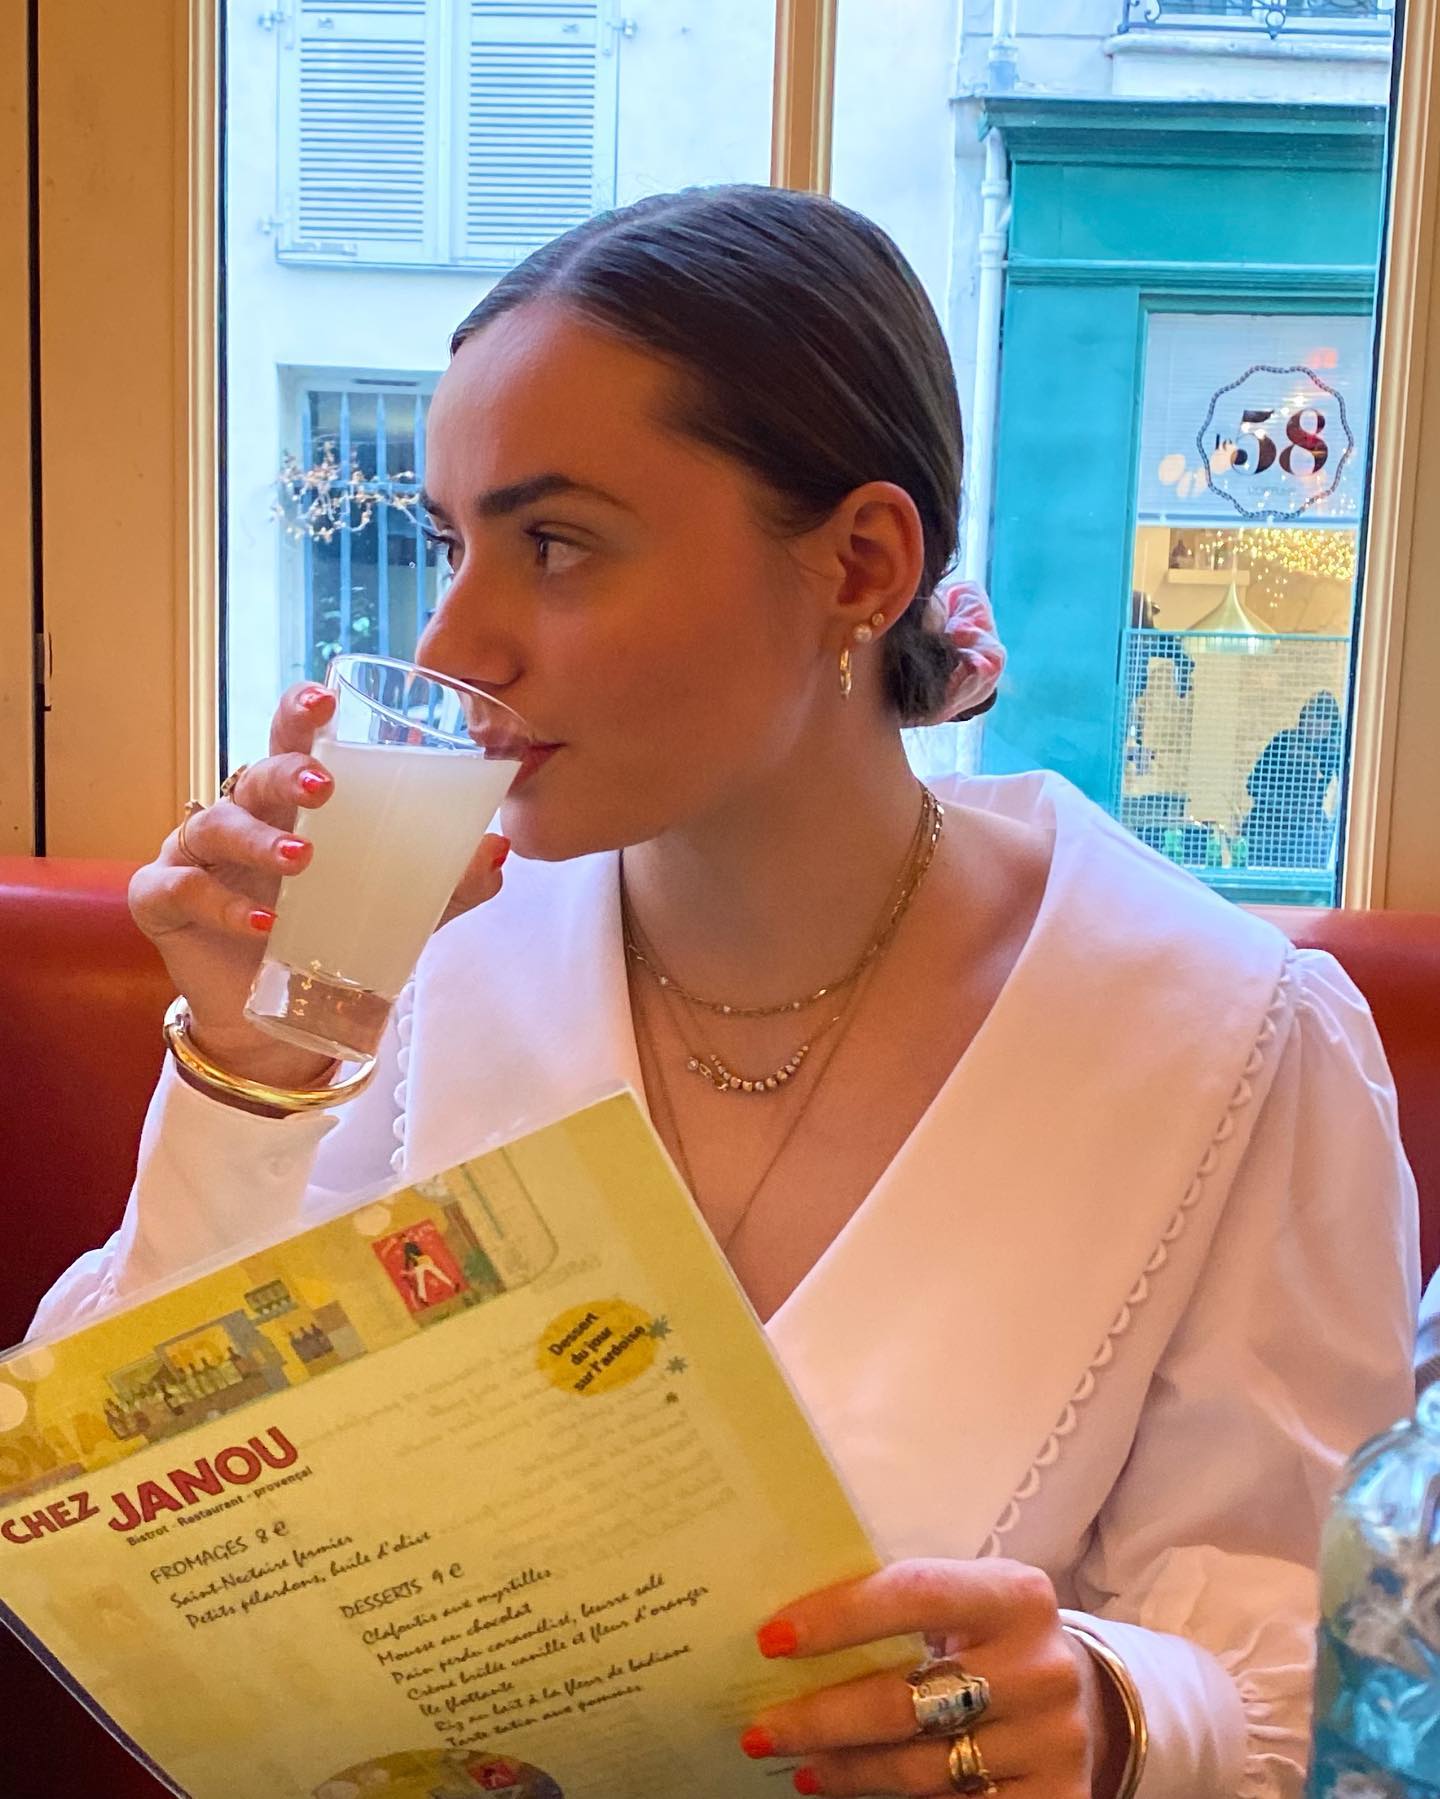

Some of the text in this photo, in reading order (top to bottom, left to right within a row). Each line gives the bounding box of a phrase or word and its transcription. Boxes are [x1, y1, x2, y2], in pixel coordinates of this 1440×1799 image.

[1231, 408, 1328, 476] 58
[548, 1312, 600, 1356] Dessert
[571, 1327, 613, 1365] du jour
[574, 1371, 595, 1391] sur
[0, 1426, 299, 1544] CHEZ JANOU
[127, 1524, 170, 1546] Bistrot
[177, 1495, 244, 1526] Restaurant
[253, 1466, 313, 1499] provençal
[150, 1520, 289, 1584] FROMAGES 8 €
[170, 1536, 353, 1609] Saint-Nectaire fermier
[185, 1605, 236, 1629] Petits
[330, 1552, 371, 1576] huile
[377, 1532, 431, 1559] d'olive
[339, 1578, 423, 1619] DESSERTS
[362, 1568, 552, 1645] Clafoutis aux myrtilles
[377, 1602, 532, 1666] Mousse au chocolat
[391, 1667, 434, 1685] Pain
[439, 1648, 482, 1672] perdu
[581, 1593, 629, 1617] beurre
[407, 1681, 457, 1700] Crème
[511, 1639, 567, 1667] vanille
[572, 1632, 586, 1646] et
[589, 1619, 629, 1643] fleur
[434, 1720, 465, 1732] Riz
[468, 1713, 489, 1723] au
[492, 1698, 523, 1715] lait
[542, 1687, 562, 1699] la
[564, 1677, 602, 1697] fleur
[607, 1664, 623, 1679] de
[628, 1645, 690, 1672] badiane
[444, 1731, 488, 1747] Tarte
[543, 1705, 572, 1720] aux
[578, 1686, 642, 1712] pommes
[445, 1681, 515, 1713] flottante
